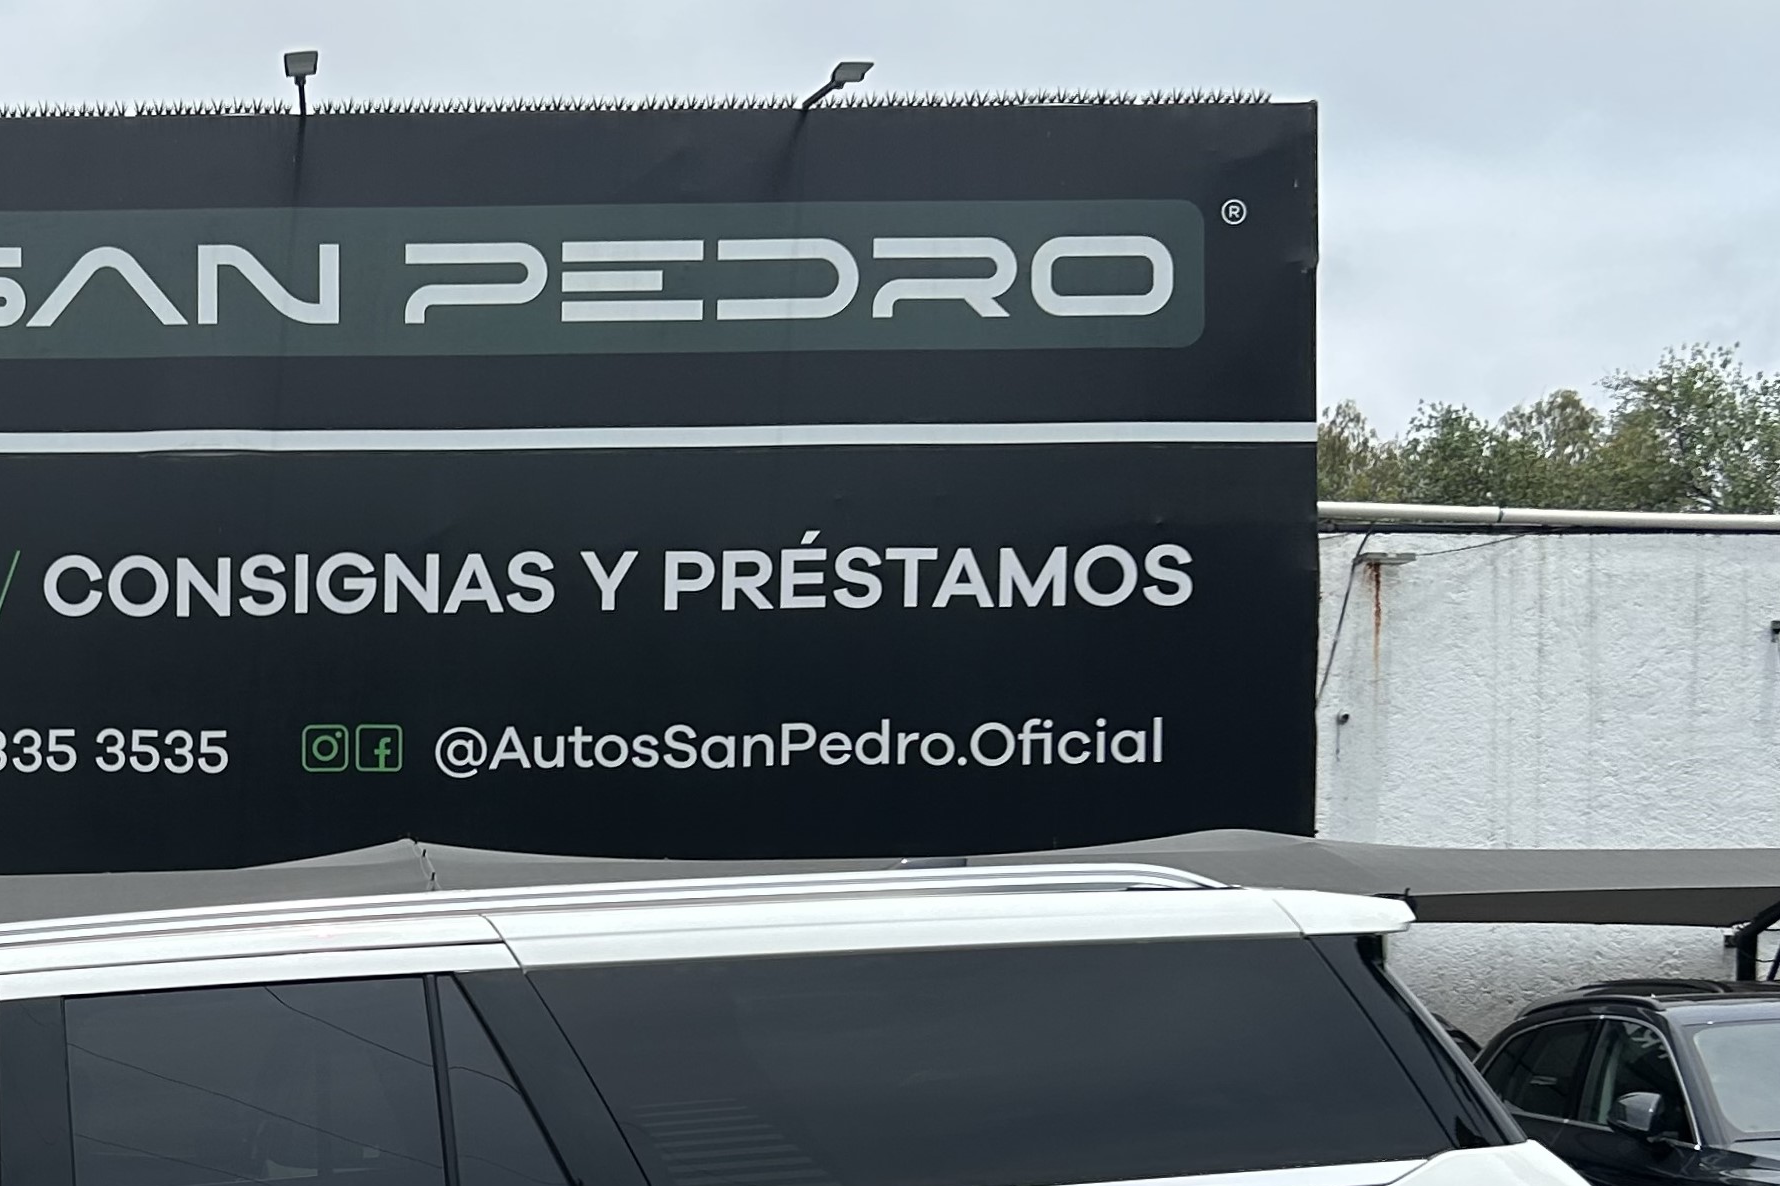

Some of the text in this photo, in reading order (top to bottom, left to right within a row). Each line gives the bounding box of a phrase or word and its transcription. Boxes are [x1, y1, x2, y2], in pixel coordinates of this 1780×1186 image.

[404, 235, 1174, 324] PEDRO
[43, 551, 555, 617] CONSIGNAS
[580, 550, 639, 611] Y
[664, 530, 1194, 611] PRÉSTAMOS
[95, 728, 229, 774] 3535
[435, 716, 1165, 780] @AutosSanPedro.Oficial
